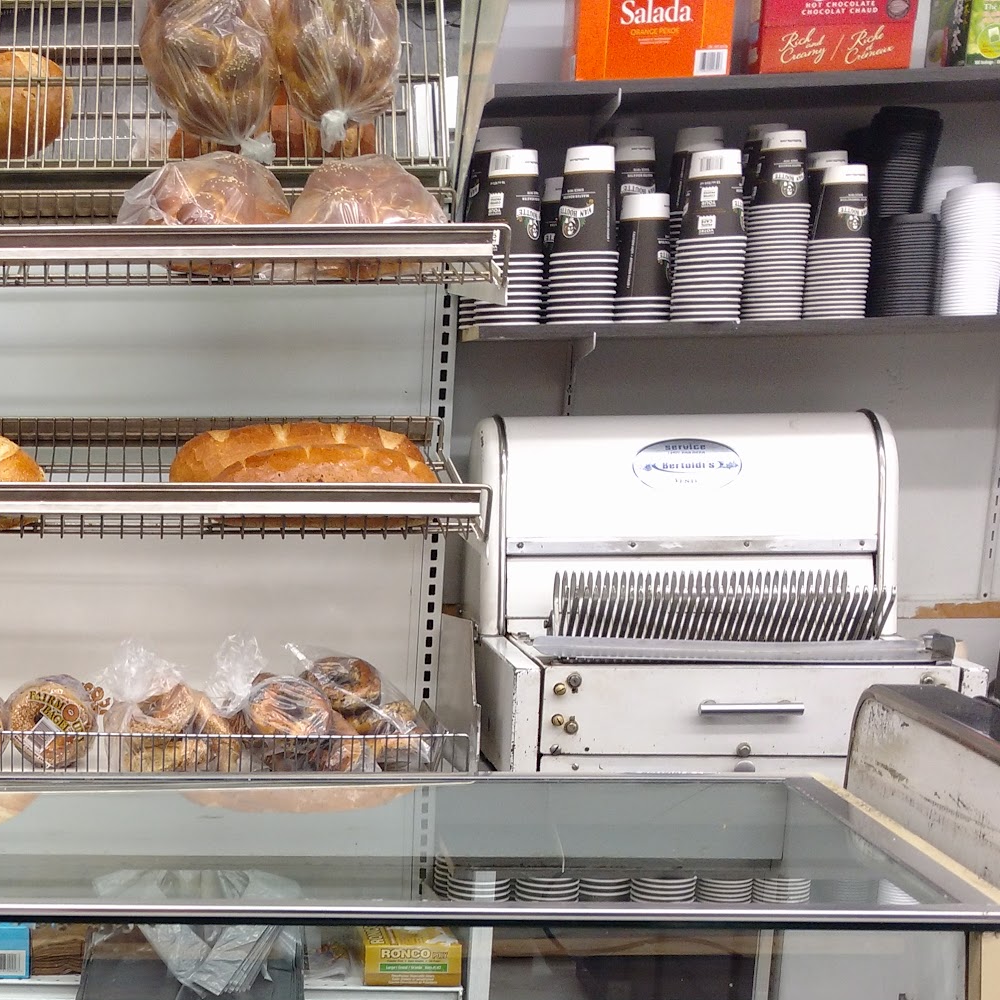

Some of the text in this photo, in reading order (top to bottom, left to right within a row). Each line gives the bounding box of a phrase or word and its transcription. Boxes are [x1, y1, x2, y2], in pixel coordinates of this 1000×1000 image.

[826, 0, 876, 8] CHOCOLATE
[620, 0, 692, 25] Salada
[630, 27, 679, 36] ORANGE PEKOE
[848, 24, 885, 51] Riche
[779, 27, 827, 64] Rich and Creamy
[580, 206, 593, 217] VAN
[381, 948, 431, 959] RONCO
